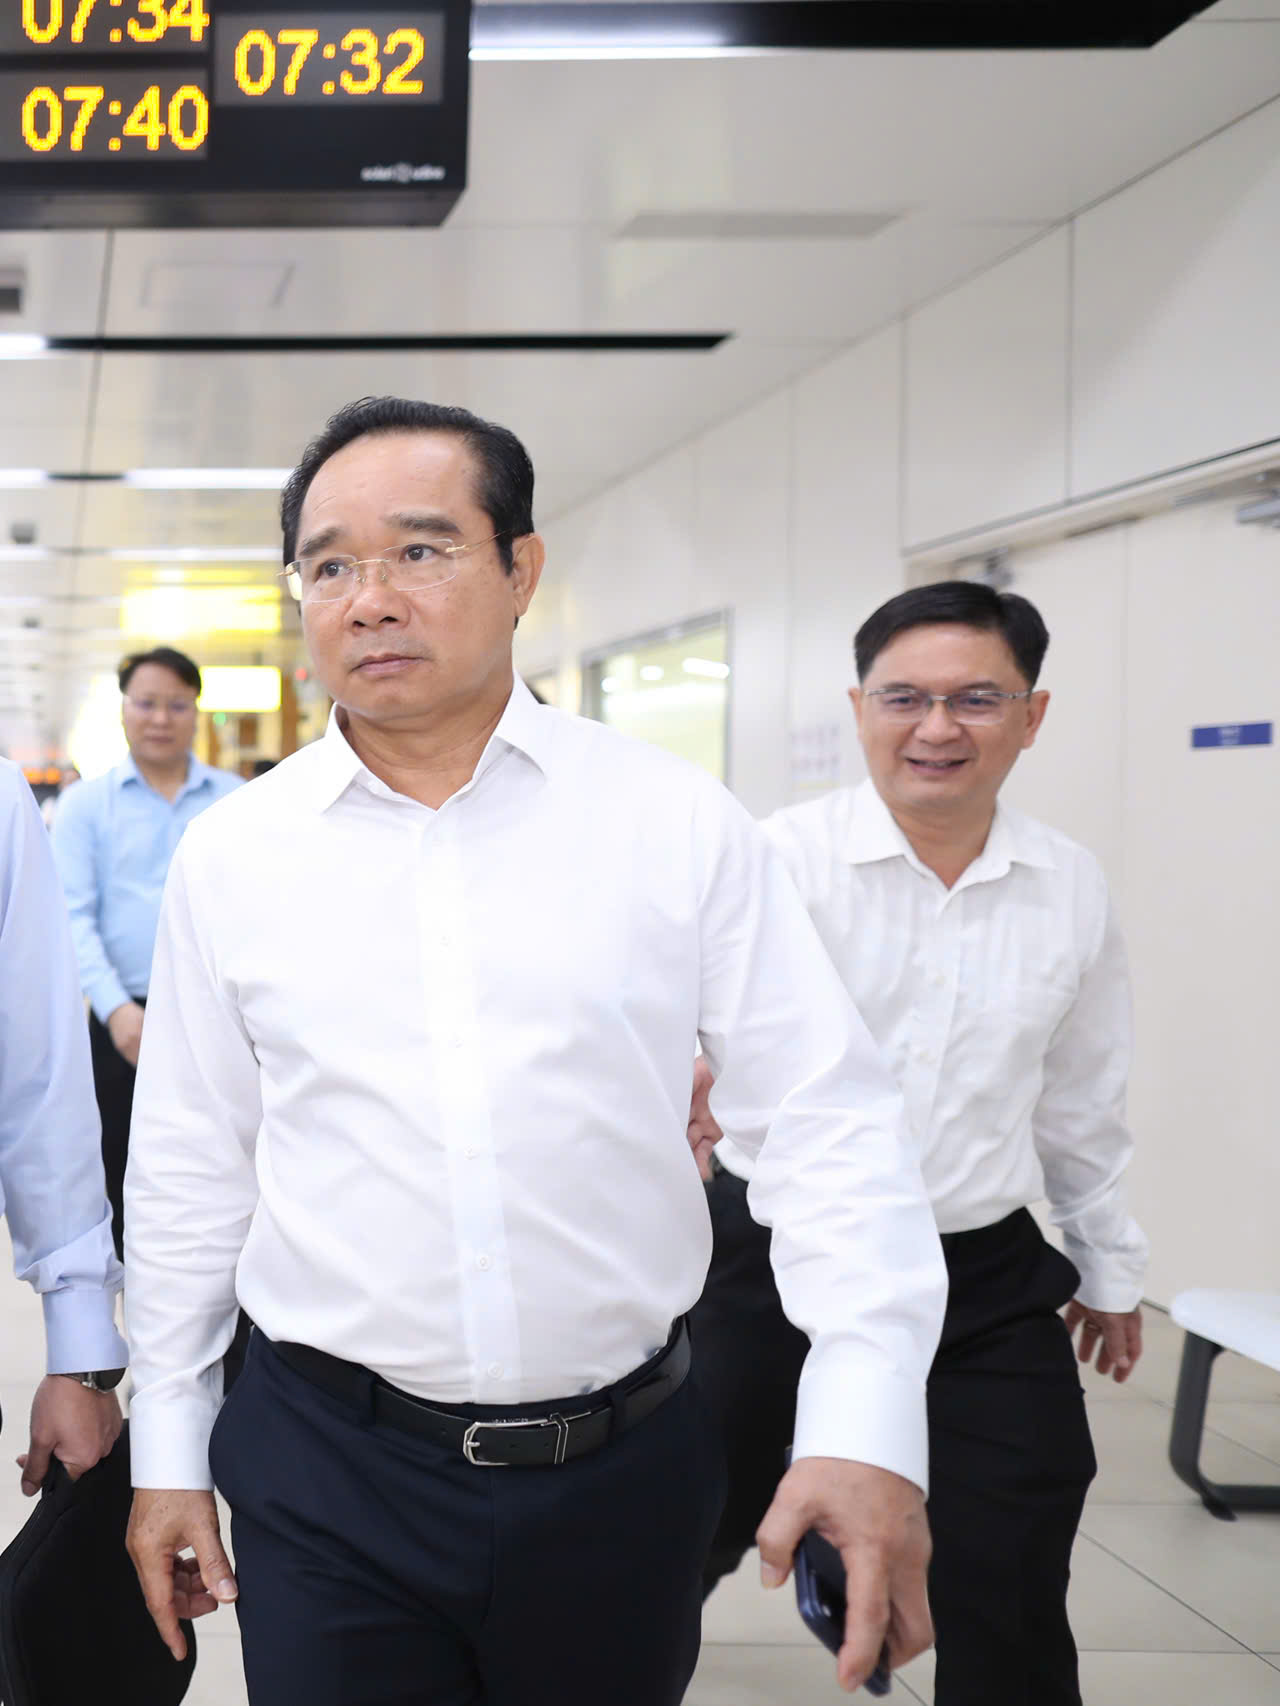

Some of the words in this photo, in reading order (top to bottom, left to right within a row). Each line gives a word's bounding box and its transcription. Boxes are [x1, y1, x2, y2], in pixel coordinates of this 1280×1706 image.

[22, 0, 210, 43] 07:34
[235, 29, 424, 96] 07:32
[22, 85, 209, 151] 07:40
